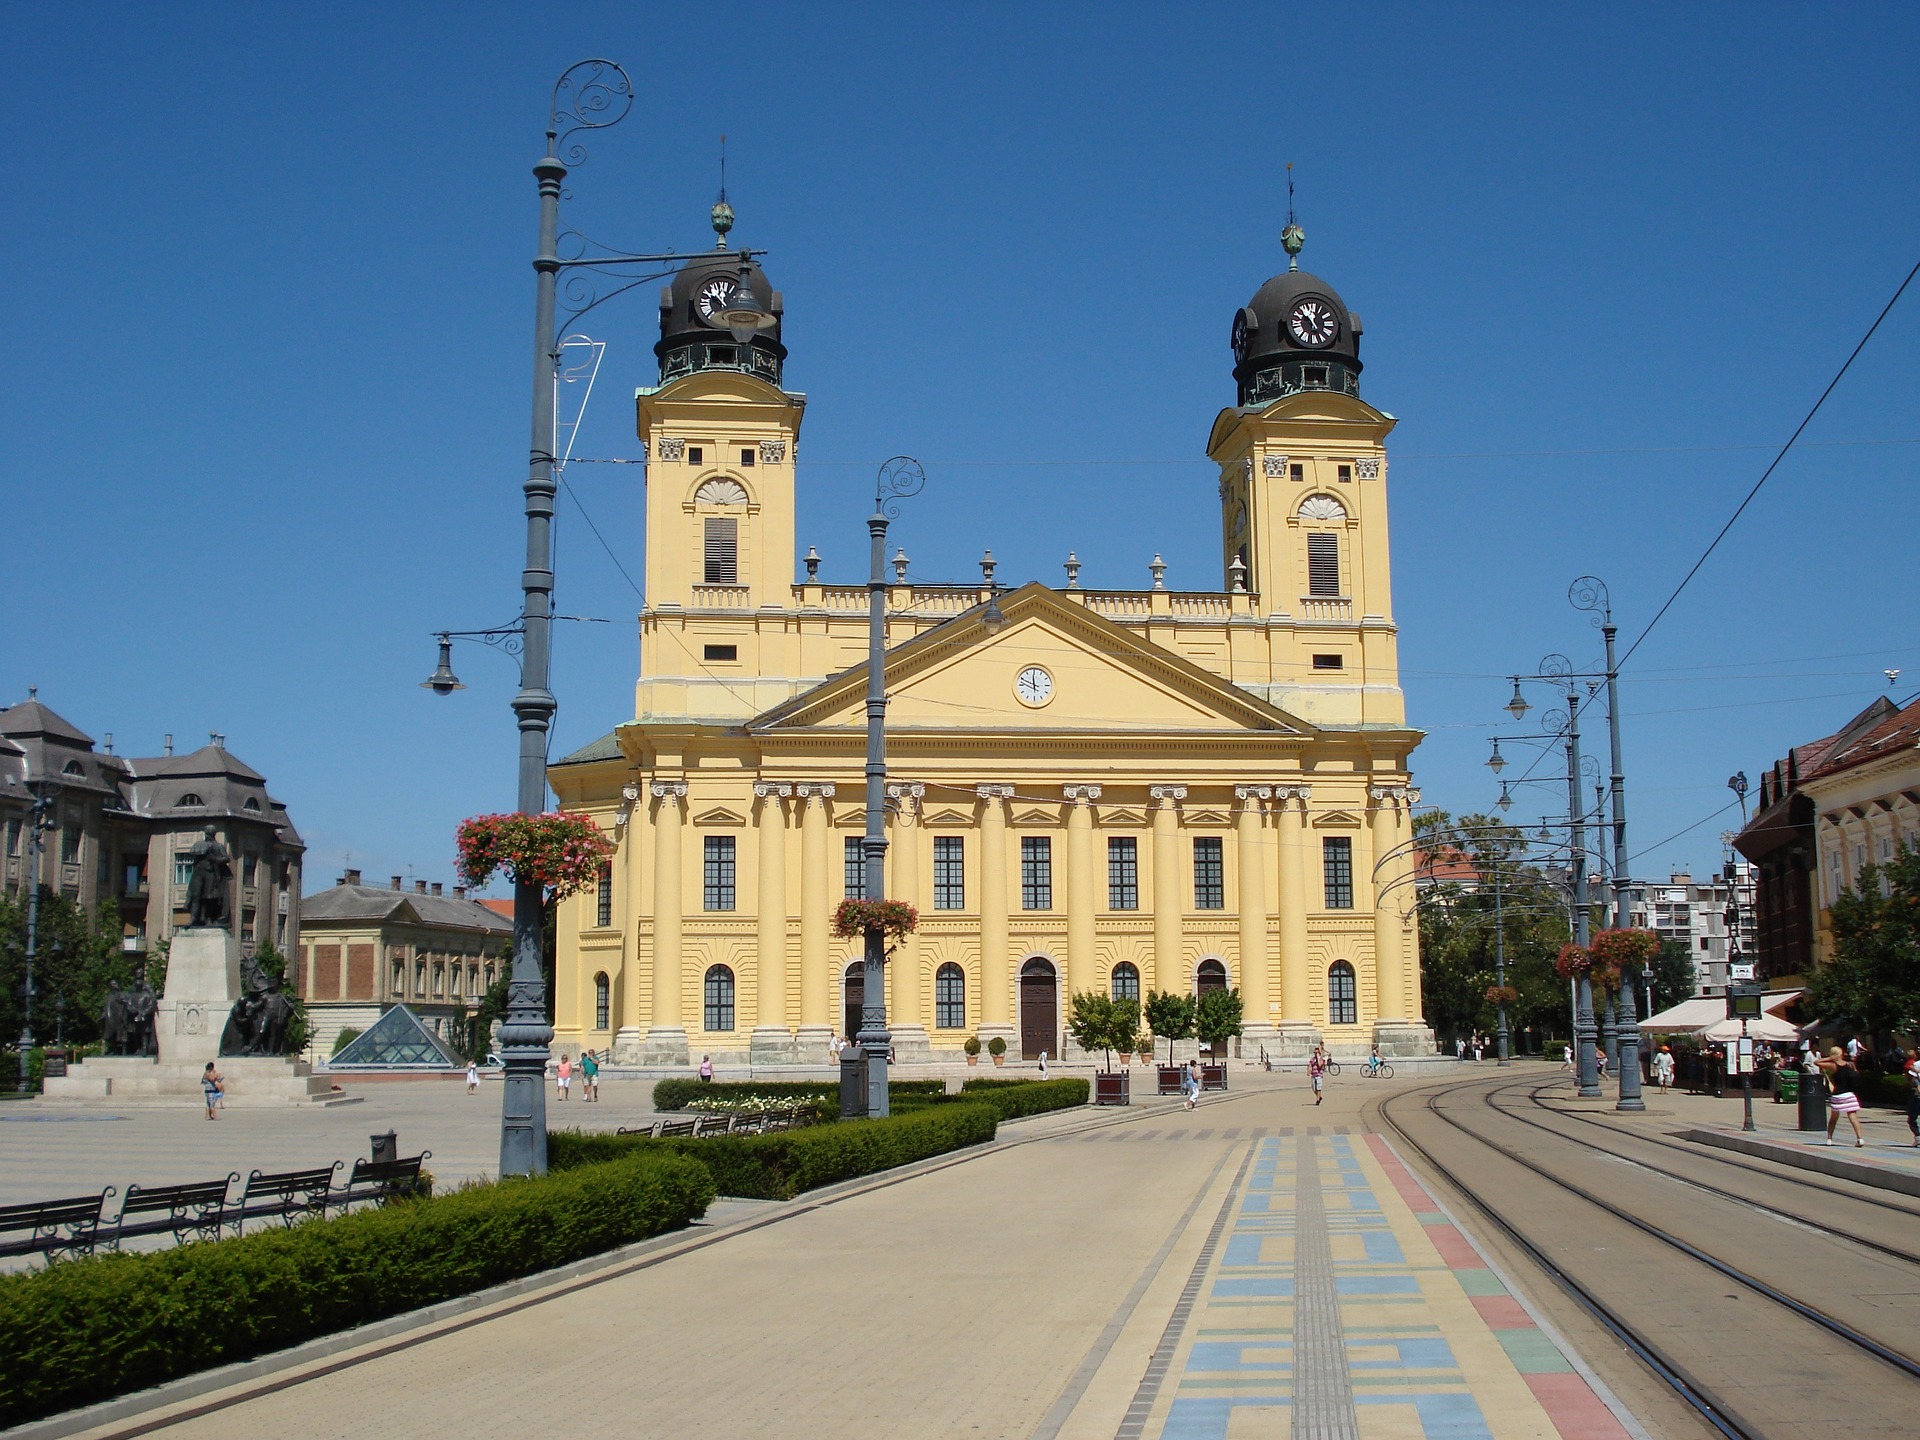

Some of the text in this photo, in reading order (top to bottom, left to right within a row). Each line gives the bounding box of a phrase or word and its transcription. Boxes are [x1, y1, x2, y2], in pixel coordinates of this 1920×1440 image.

[702, 289, 712, 298] X
[728, 285, 735, 294] I
[1293, 311, 1303, 319] X
[1318, 333, 1326, 342] V
